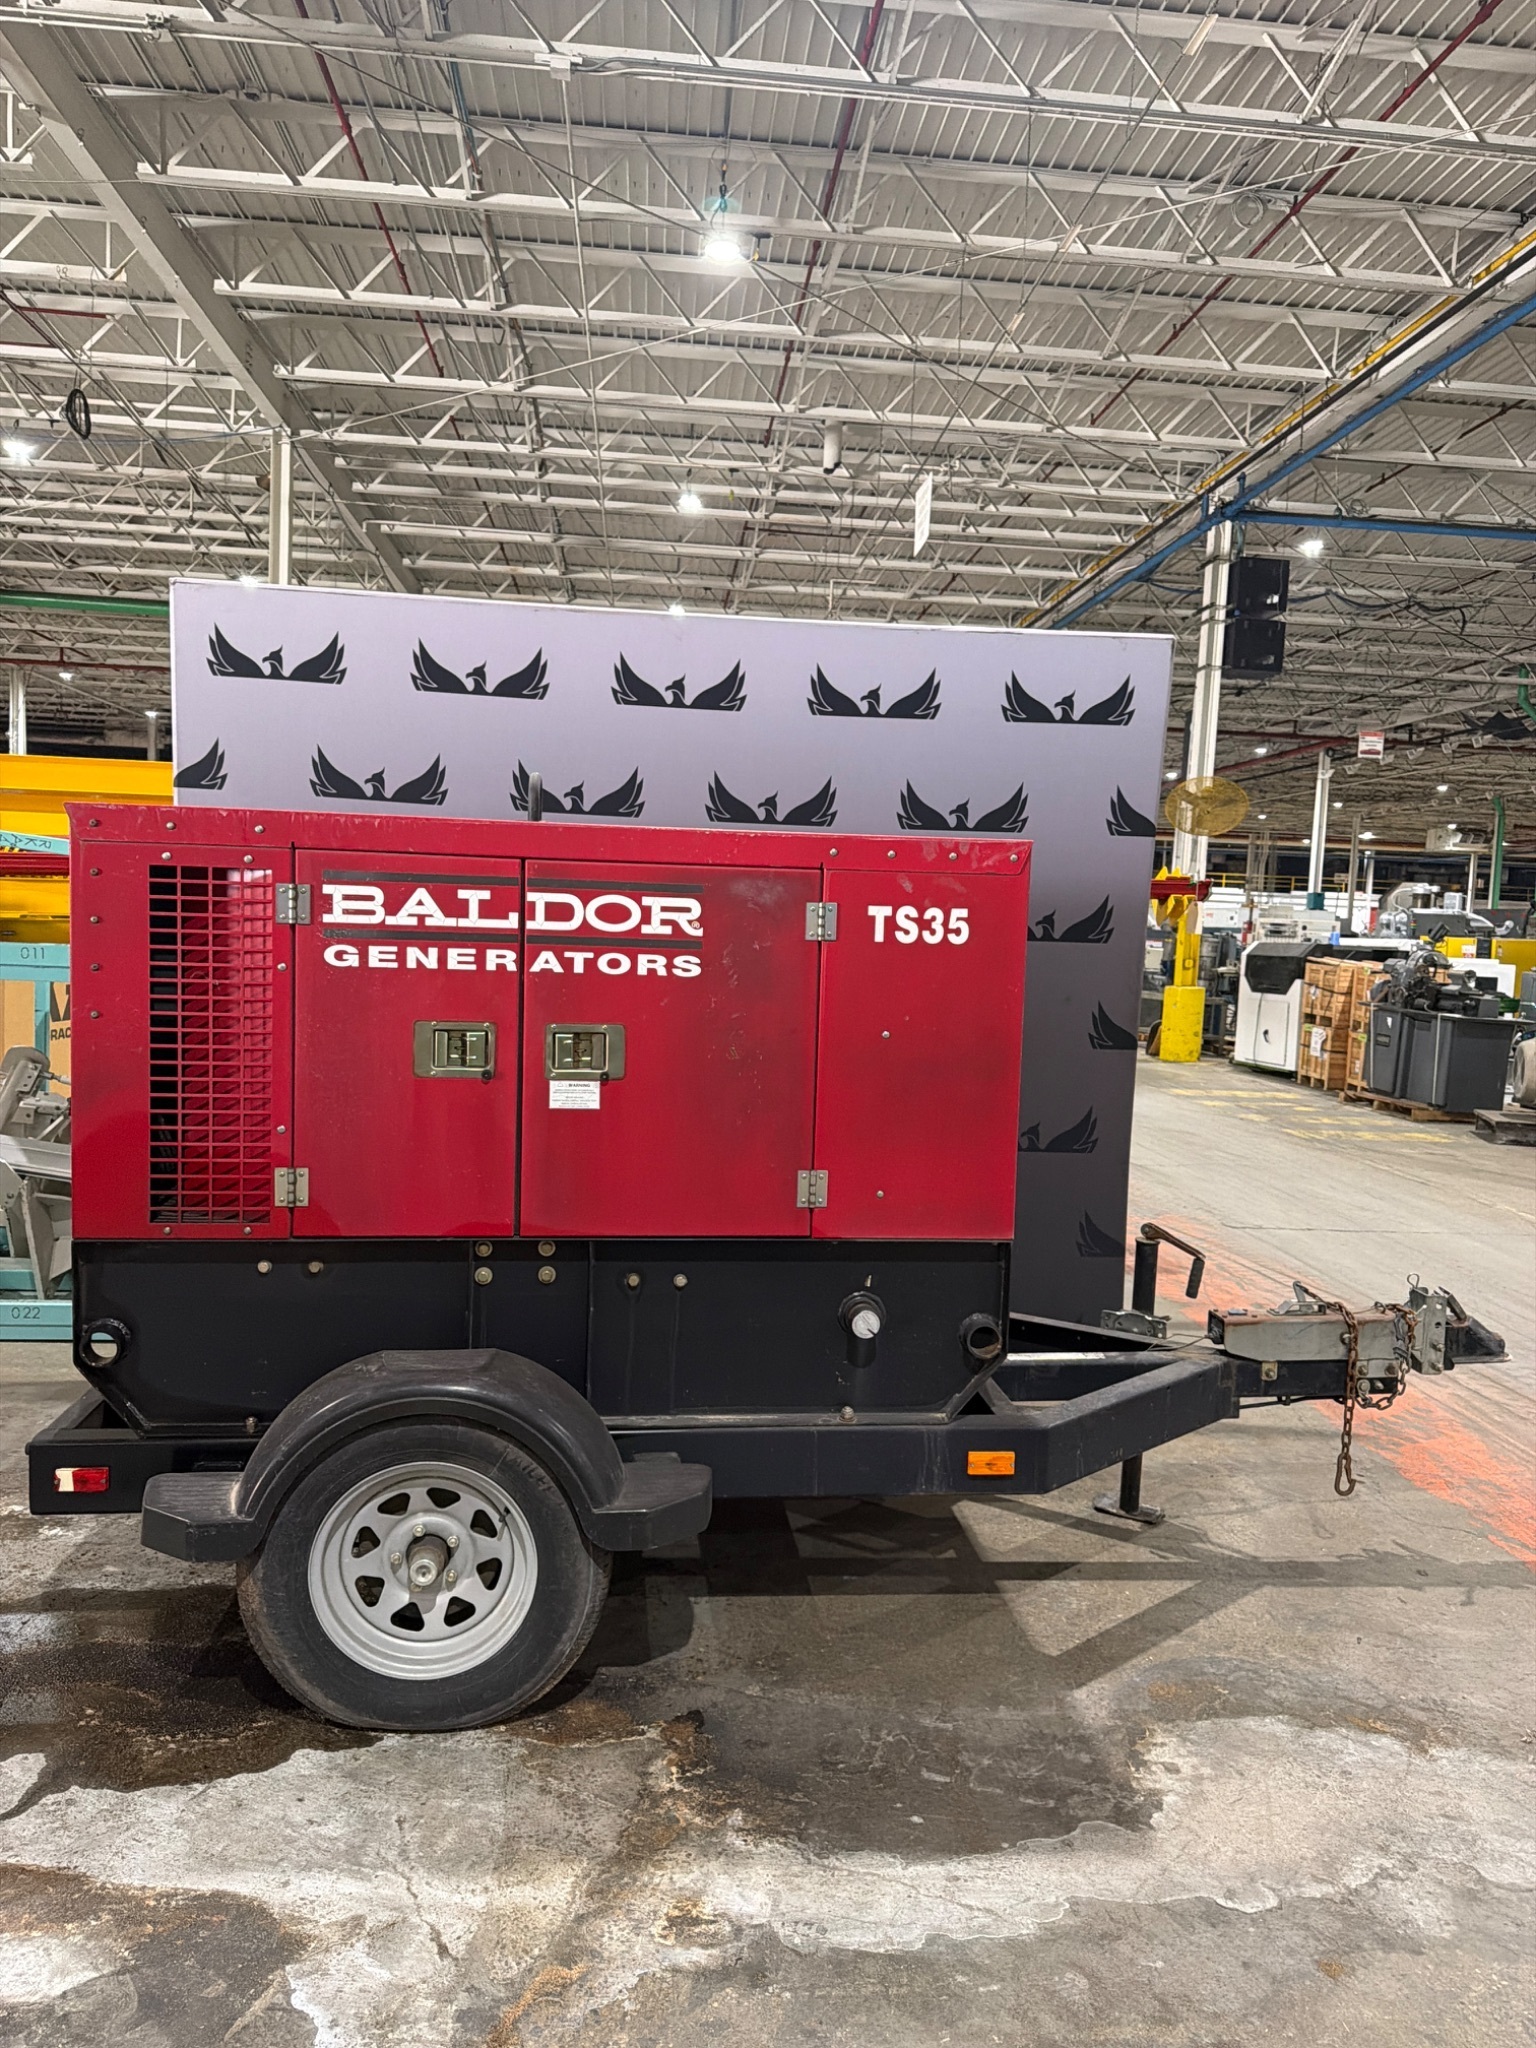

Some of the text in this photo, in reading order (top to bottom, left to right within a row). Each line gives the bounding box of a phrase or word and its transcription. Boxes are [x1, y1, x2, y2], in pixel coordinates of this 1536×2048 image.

[322, 884, 704, 937] BALDOR
[867, 905, 970, 945] TS35
[20, 946, 45, 960] 011
[323, 944, 702, 978] GENERATORS
[11, 1306, 41, 1319] 022
